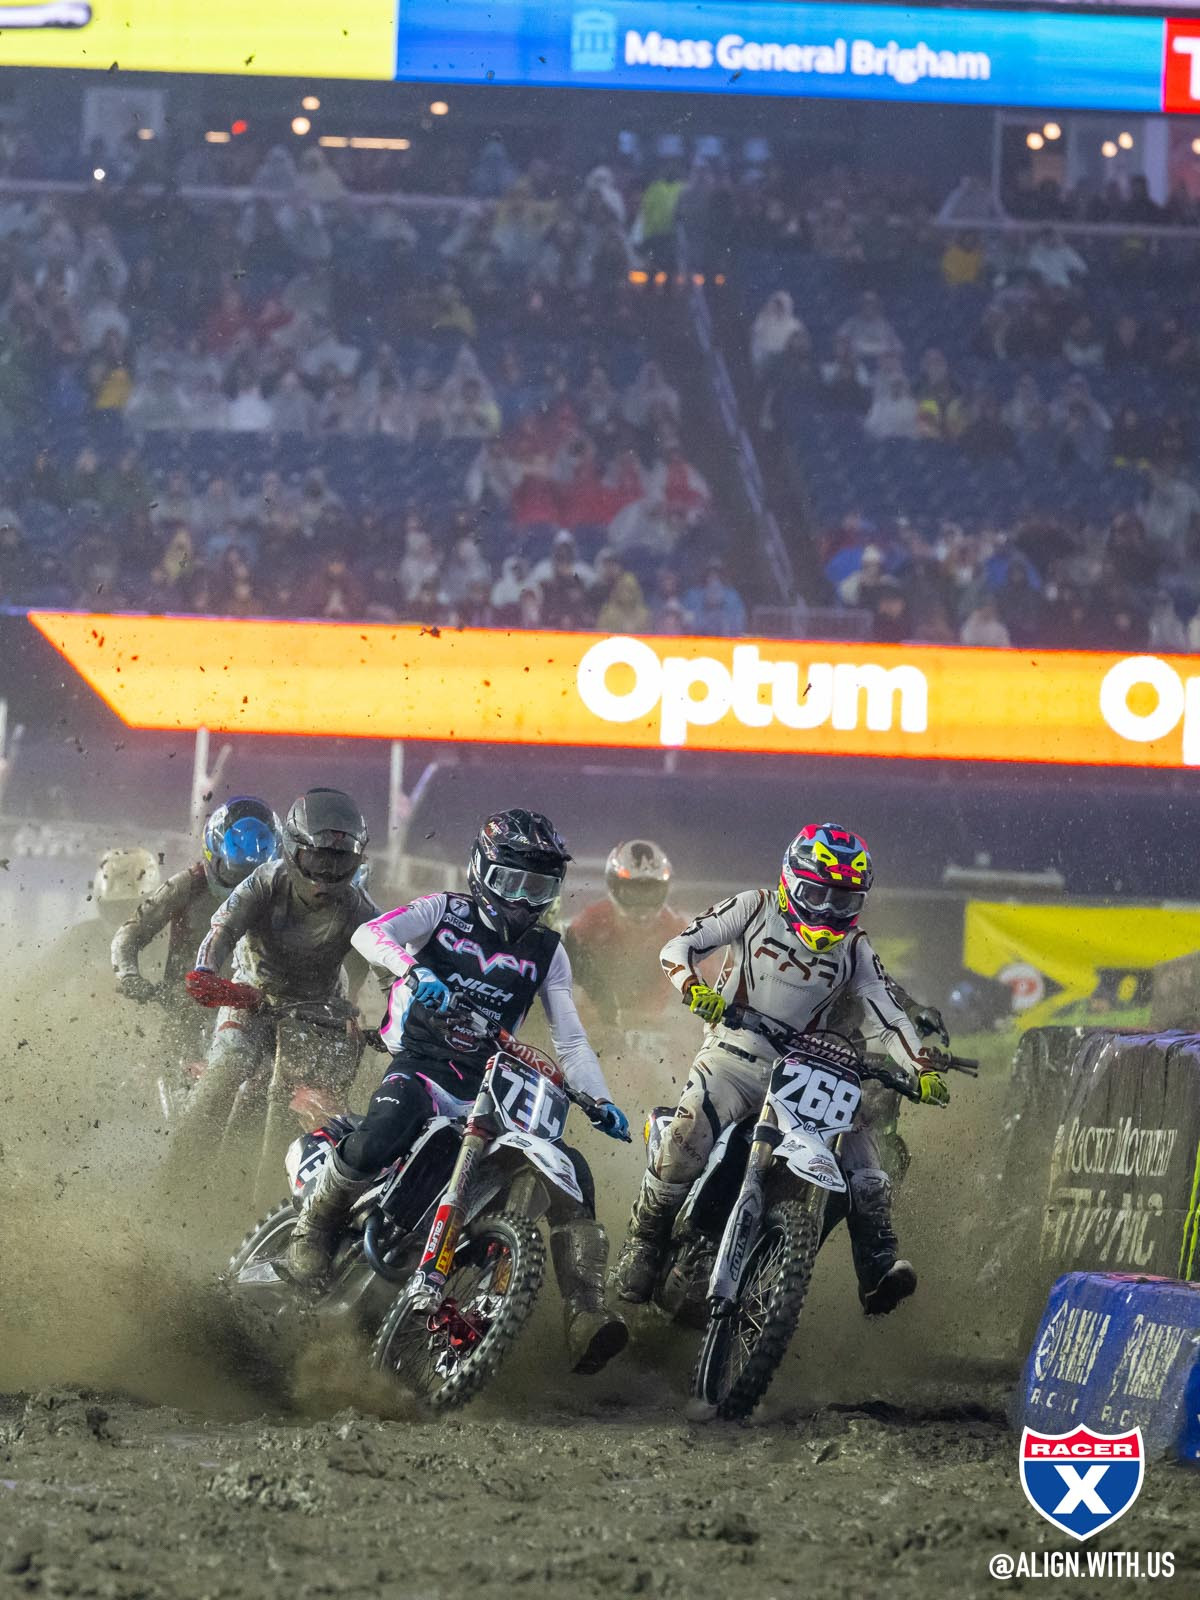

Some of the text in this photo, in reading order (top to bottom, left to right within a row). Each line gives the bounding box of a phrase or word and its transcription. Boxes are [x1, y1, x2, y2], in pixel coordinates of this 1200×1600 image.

[623, 30, 991, 84] Mass General Brigham
[576, 636, 929, 745] Optum
[447, 973, 514, 1002] NICH
[501, 1071, 561, 1137] 734
[774, 1064, 862, 1128] 268
